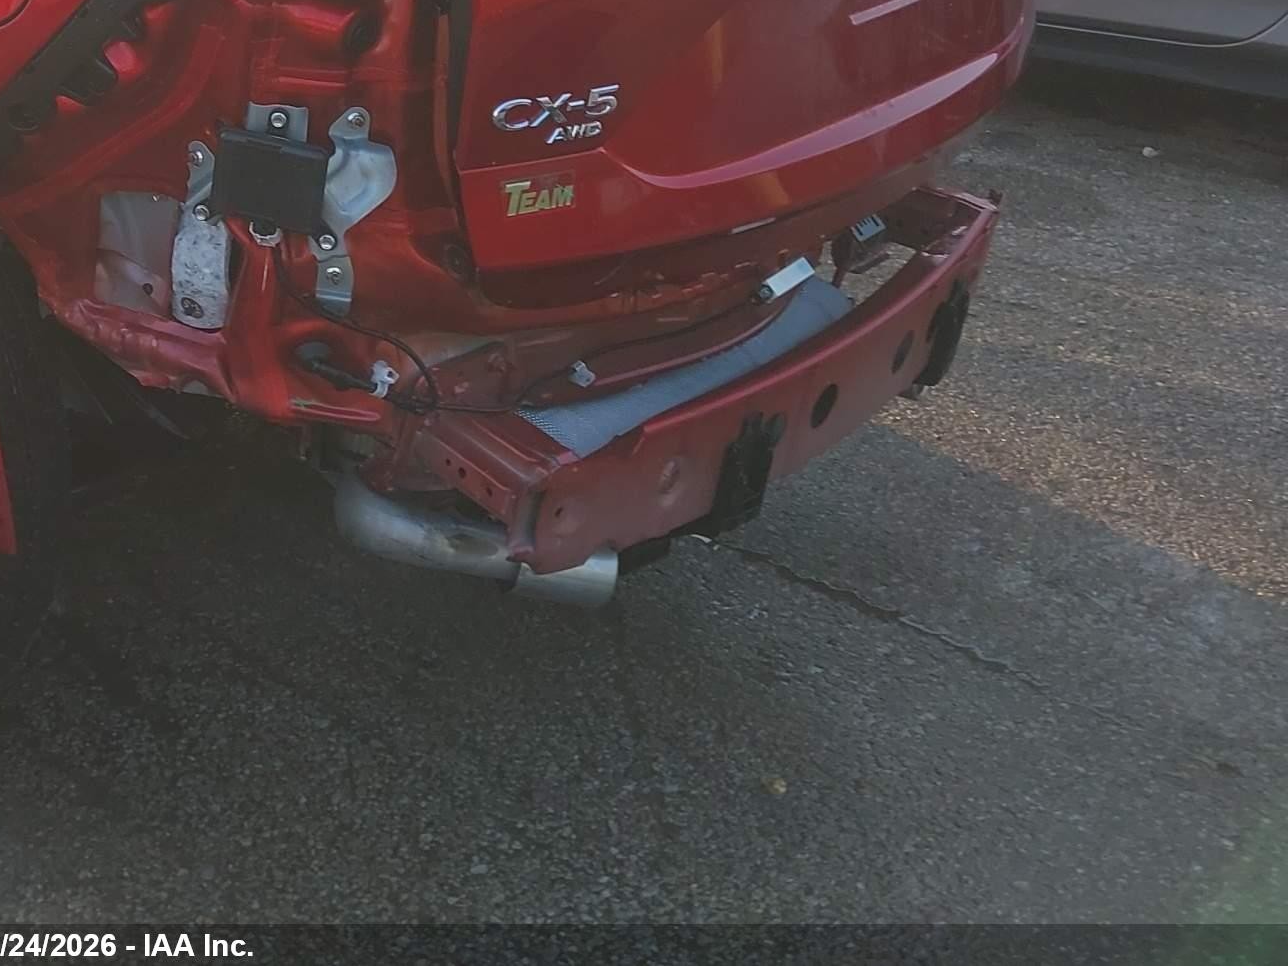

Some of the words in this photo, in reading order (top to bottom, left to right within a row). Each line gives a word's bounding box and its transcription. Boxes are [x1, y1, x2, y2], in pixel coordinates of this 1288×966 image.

[492, 84, 620, 131] CX-5
[546, 120, 603, 145] AWD
[505, 181, 574, 217] TEAM
